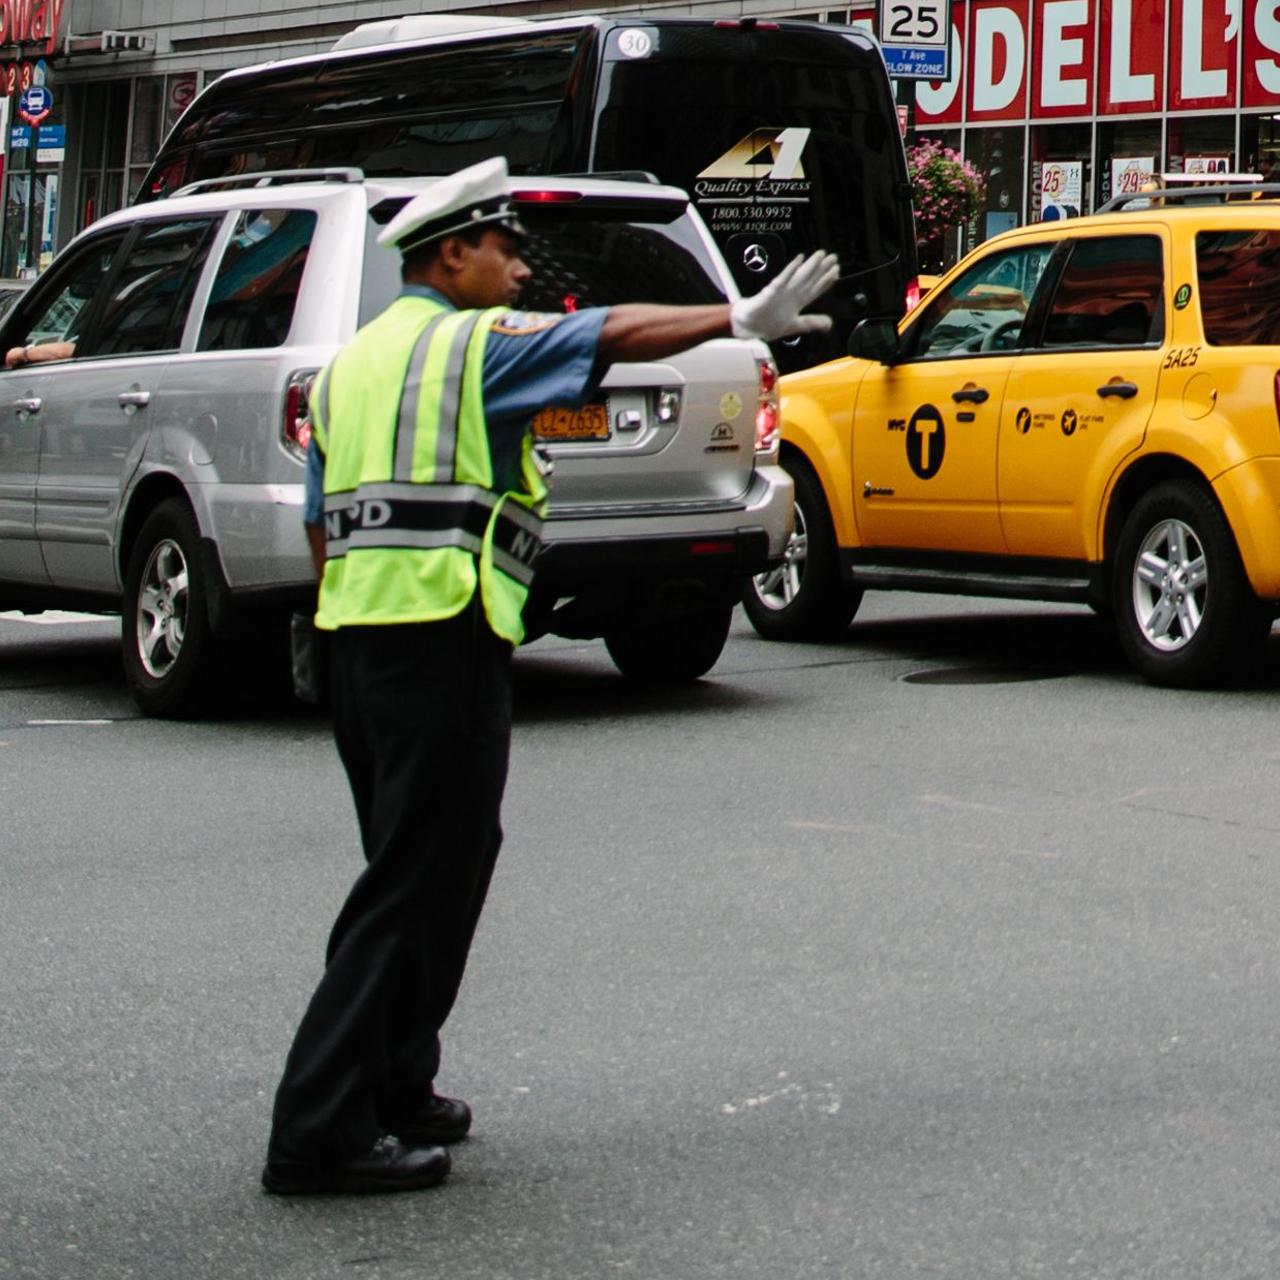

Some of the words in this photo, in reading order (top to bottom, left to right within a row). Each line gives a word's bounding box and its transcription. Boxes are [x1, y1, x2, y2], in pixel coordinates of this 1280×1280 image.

[890, 5, 939, 38] 25
[902, 50, 908, 59] 7
[910, 51, 926, 60] Ave
[915, 63, 944, 73] ZONE
[8, 69, 16, 91] 2
[22, 68, 30, 89] 3
[694, 179, 750, 196] Quality
[755, 180, 812, 195] Express
[712, 206, 793, 219] 1800.530.9952
[915, 418, 938, 470] T
